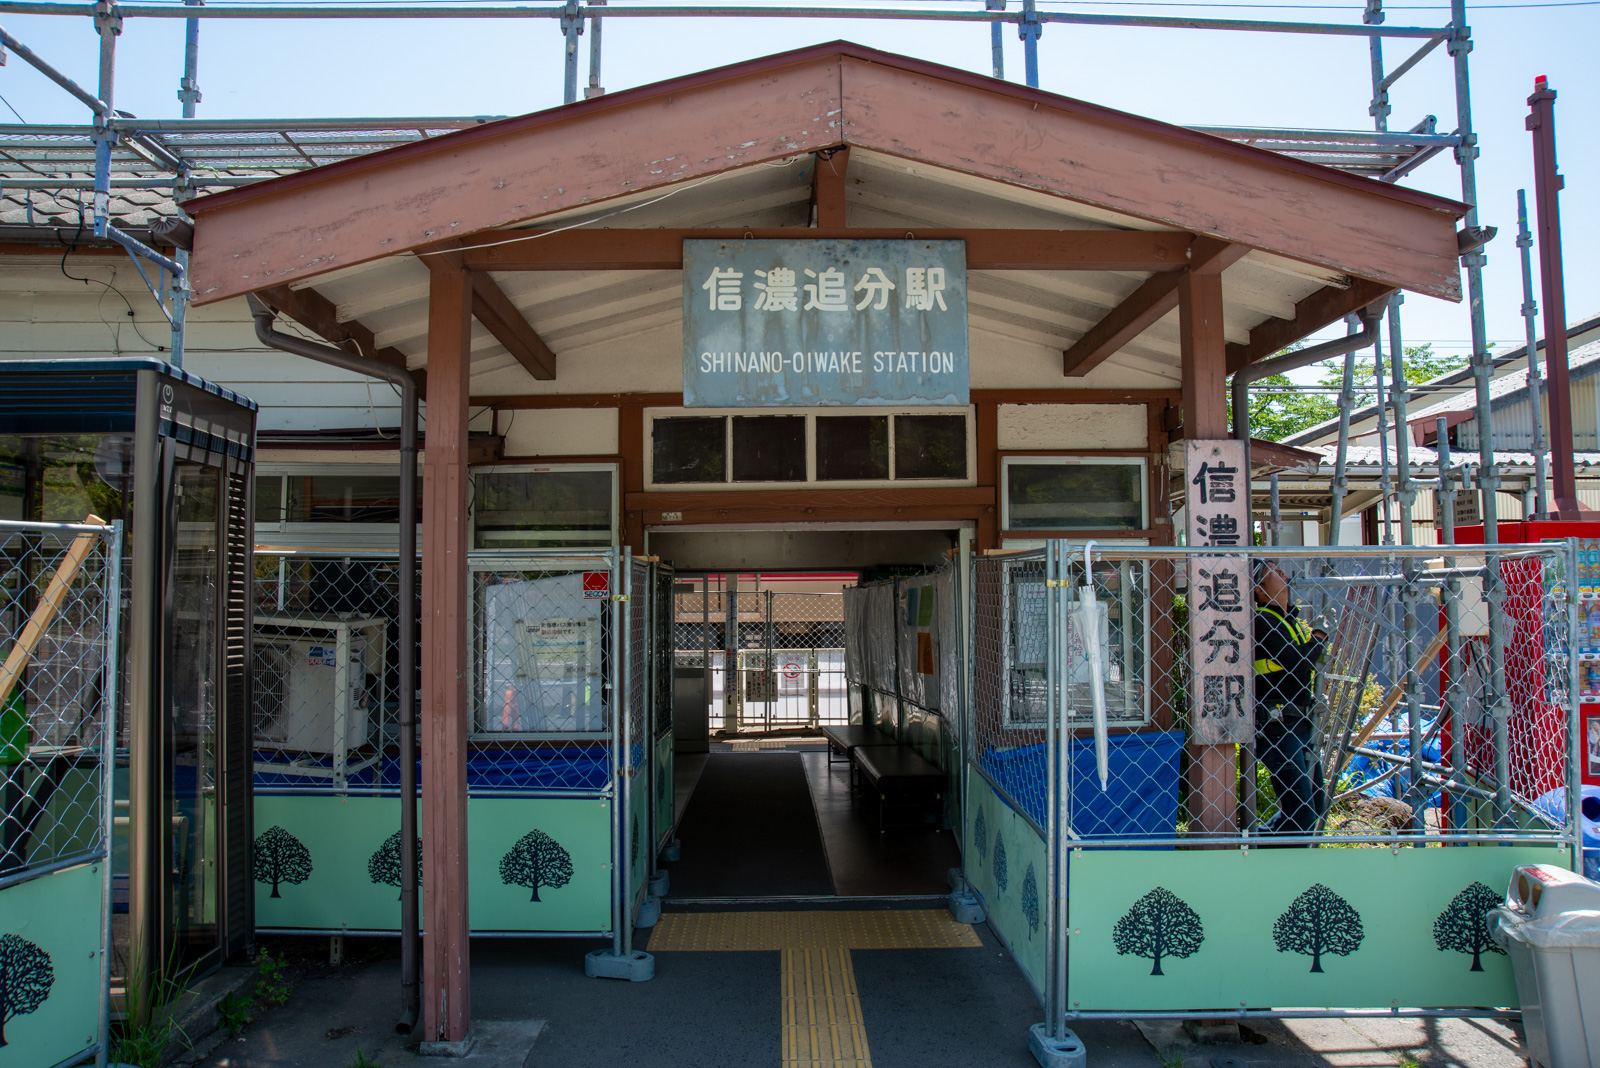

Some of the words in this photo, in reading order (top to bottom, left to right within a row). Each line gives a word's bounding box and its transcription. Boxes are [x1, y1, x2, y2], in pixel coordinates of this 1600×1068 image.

[702, 267, 948, 312] 信濃追分駅
[700, 351, 863, 374] SHINANO-OIWAKE
[873, 351, 954, 374] STATION
